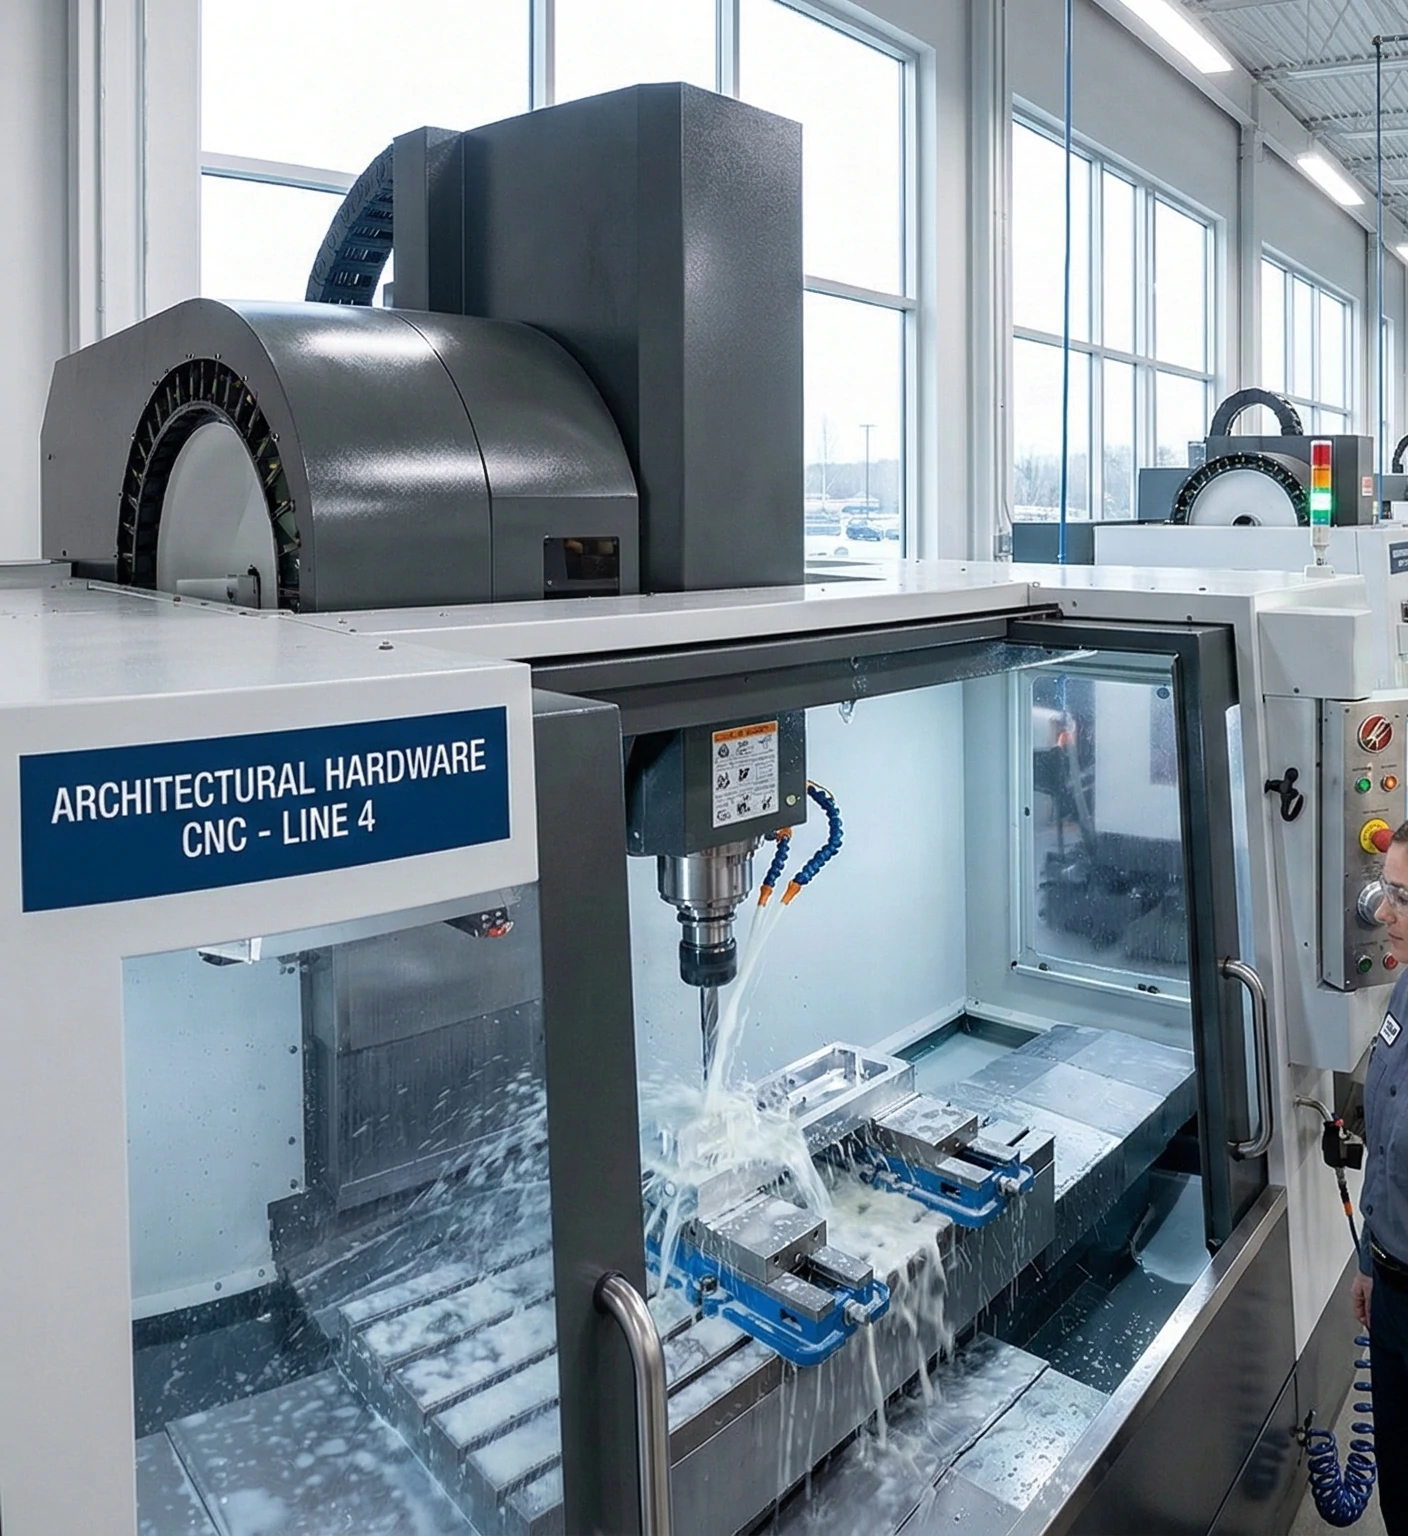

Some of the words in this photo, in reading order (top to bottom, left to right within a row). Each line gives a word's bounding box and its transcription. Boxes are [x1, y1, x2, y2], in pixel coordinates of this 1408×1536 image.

[51, 761, 316, 824] ARCHITECTURAL
[325, 738, 487, 792] HARDWARE
[182, 816, 248, 859] CNC
[283, 802, 349, 845] LINE
[357, 800, 377, 833] 4
